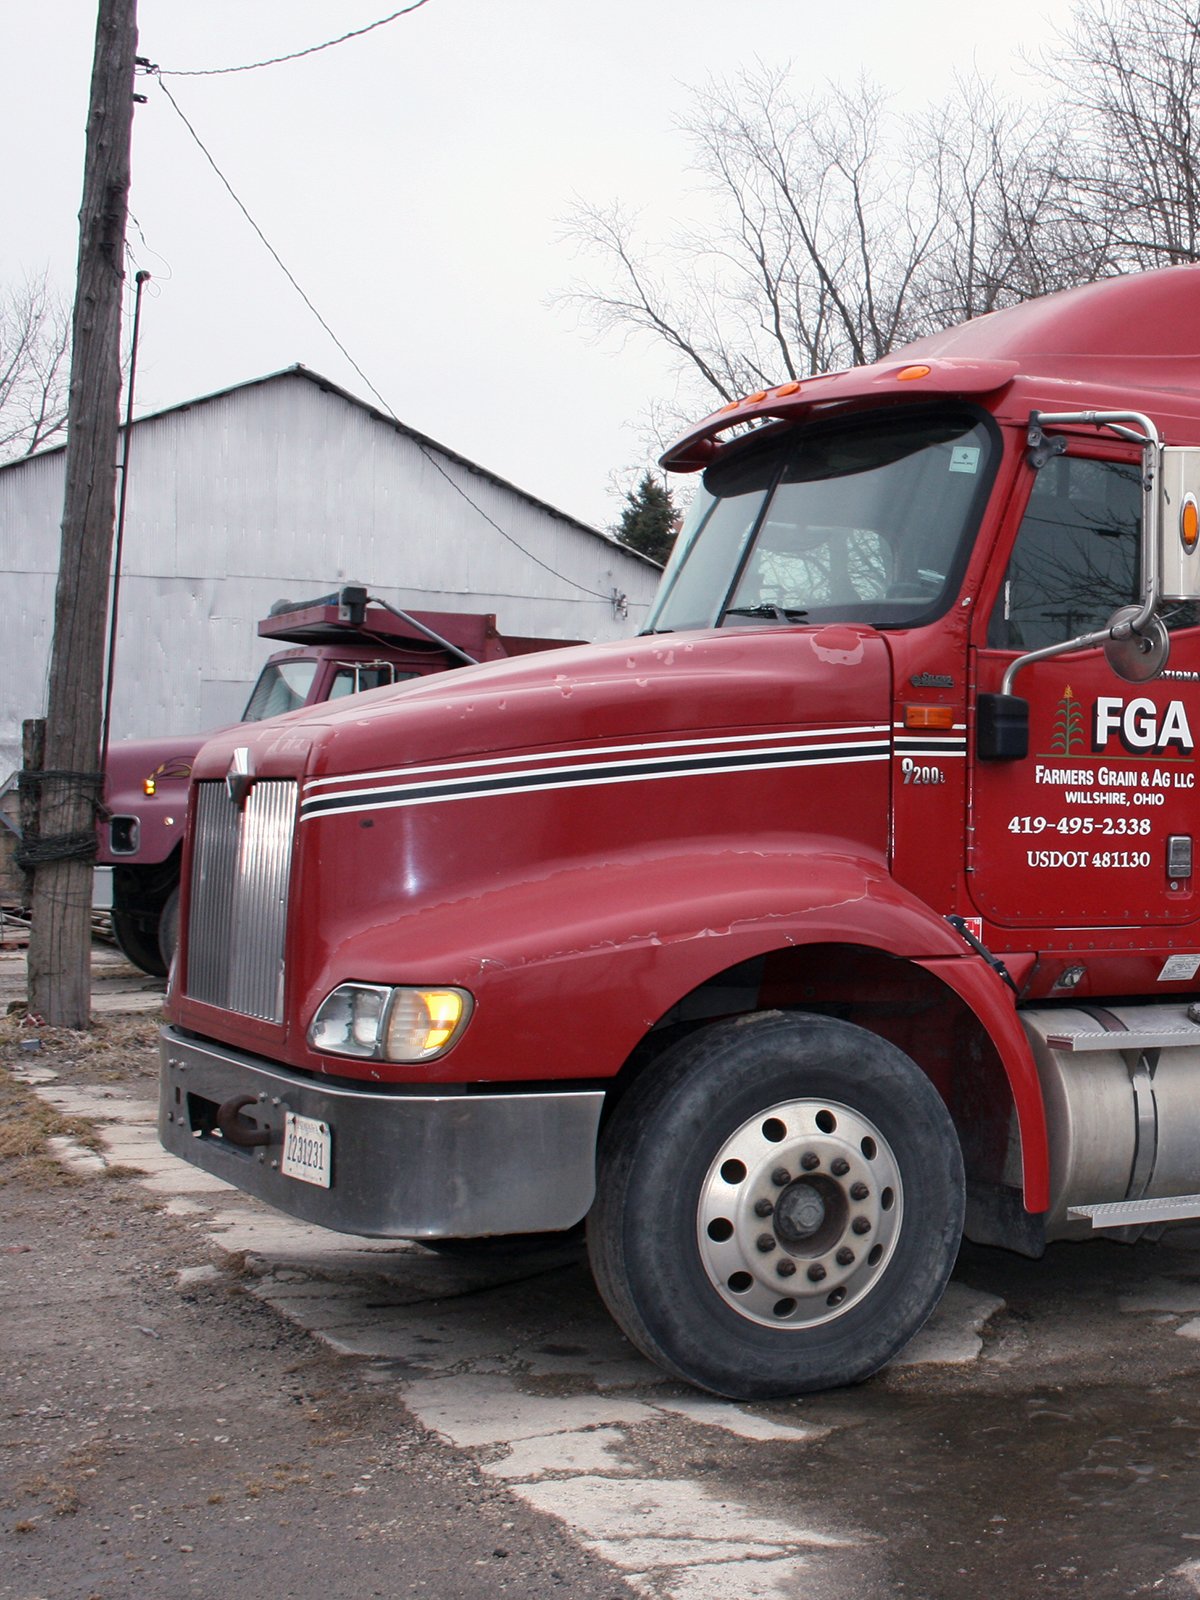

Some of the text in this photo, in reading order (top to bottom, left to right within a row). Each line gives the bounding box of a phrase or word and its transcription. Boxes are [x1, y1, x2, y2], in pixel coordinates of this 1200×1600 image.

[1096, 696, 1195, 748] FGA
[902, 757, 946, 785] 9200i
[1140, 771, 1150, 787] &
[1174, 772, 1195, 789] LLC
[1064, 791, 1165, 807] WILLSHIRE, OHIO
[1007, 815, 1152, 836] 419-495-2338
[1026, 850, 1151, 868] USDOT 481130
